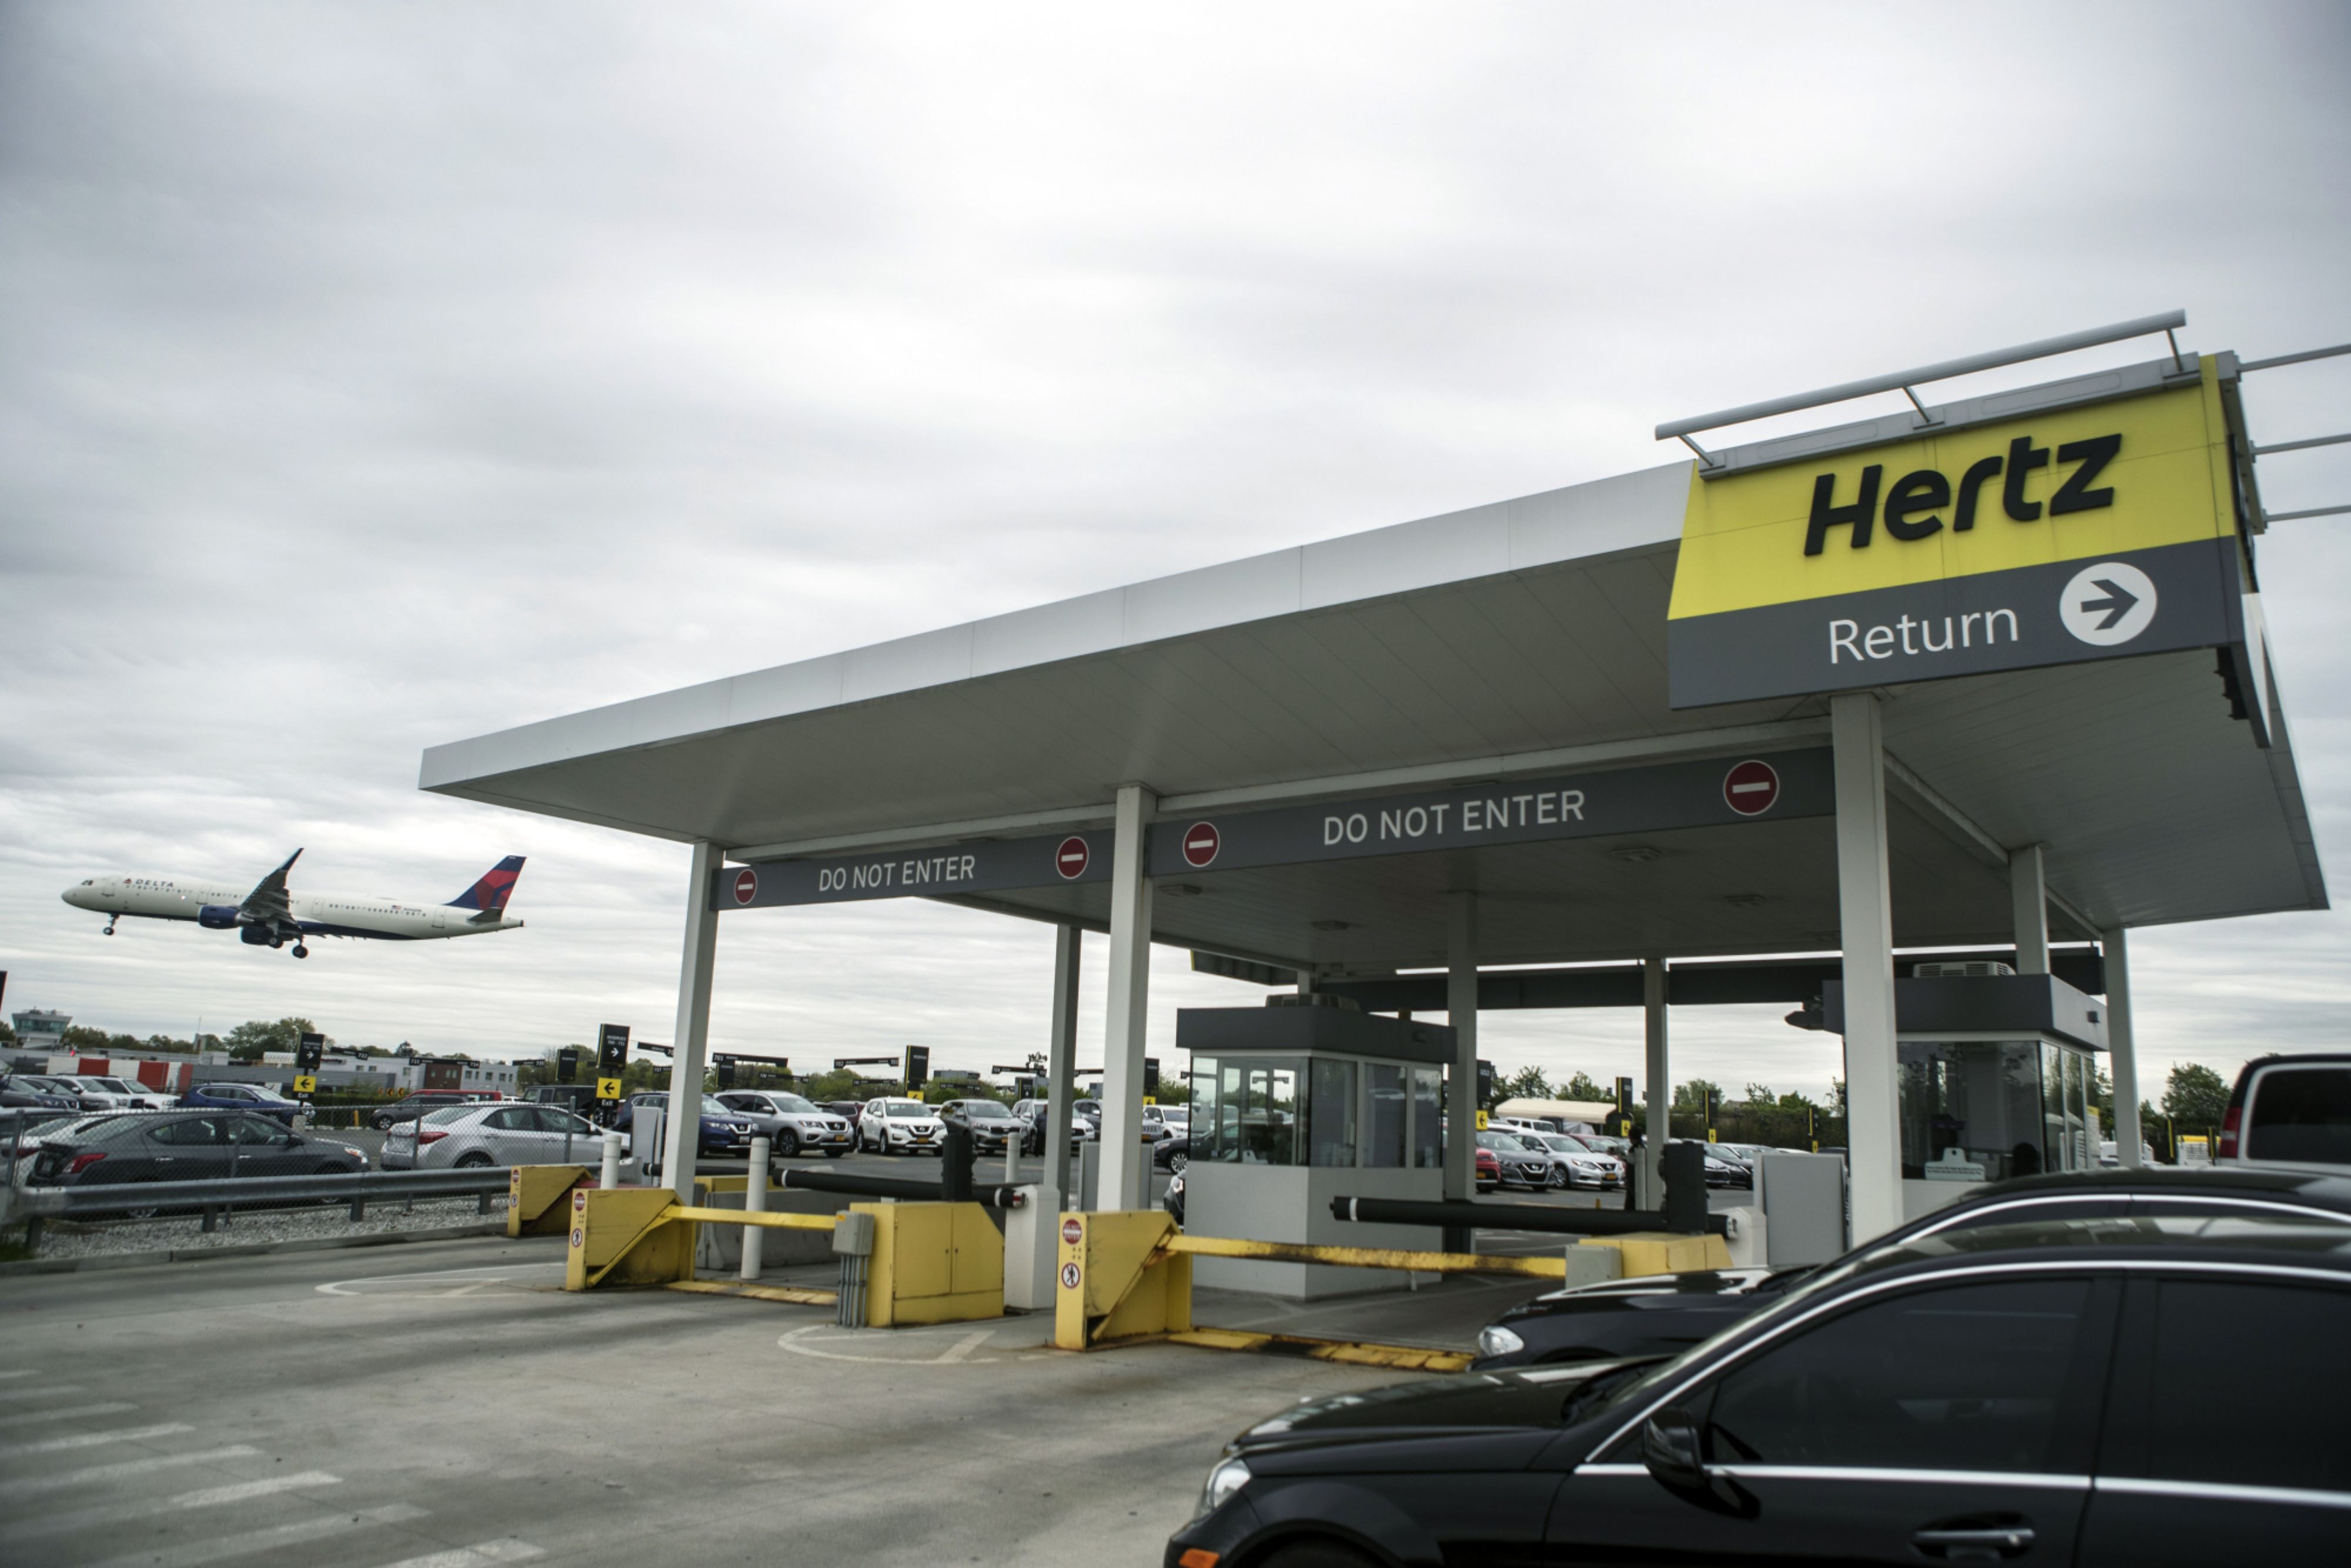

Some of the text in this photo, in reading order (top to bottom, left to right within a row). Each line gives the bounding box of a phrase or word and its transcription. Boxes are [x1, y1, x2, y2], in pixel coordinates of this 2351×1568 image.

[1804, 433, 2122, 556] Hertz
[1829, 609, 2019, 664] Return
[1323, 789, 1585, 845] DO NOT ENTER
[135, 878, 174, 887] DELTA
[818, 854, 976, 892] DO NOT ENTER
